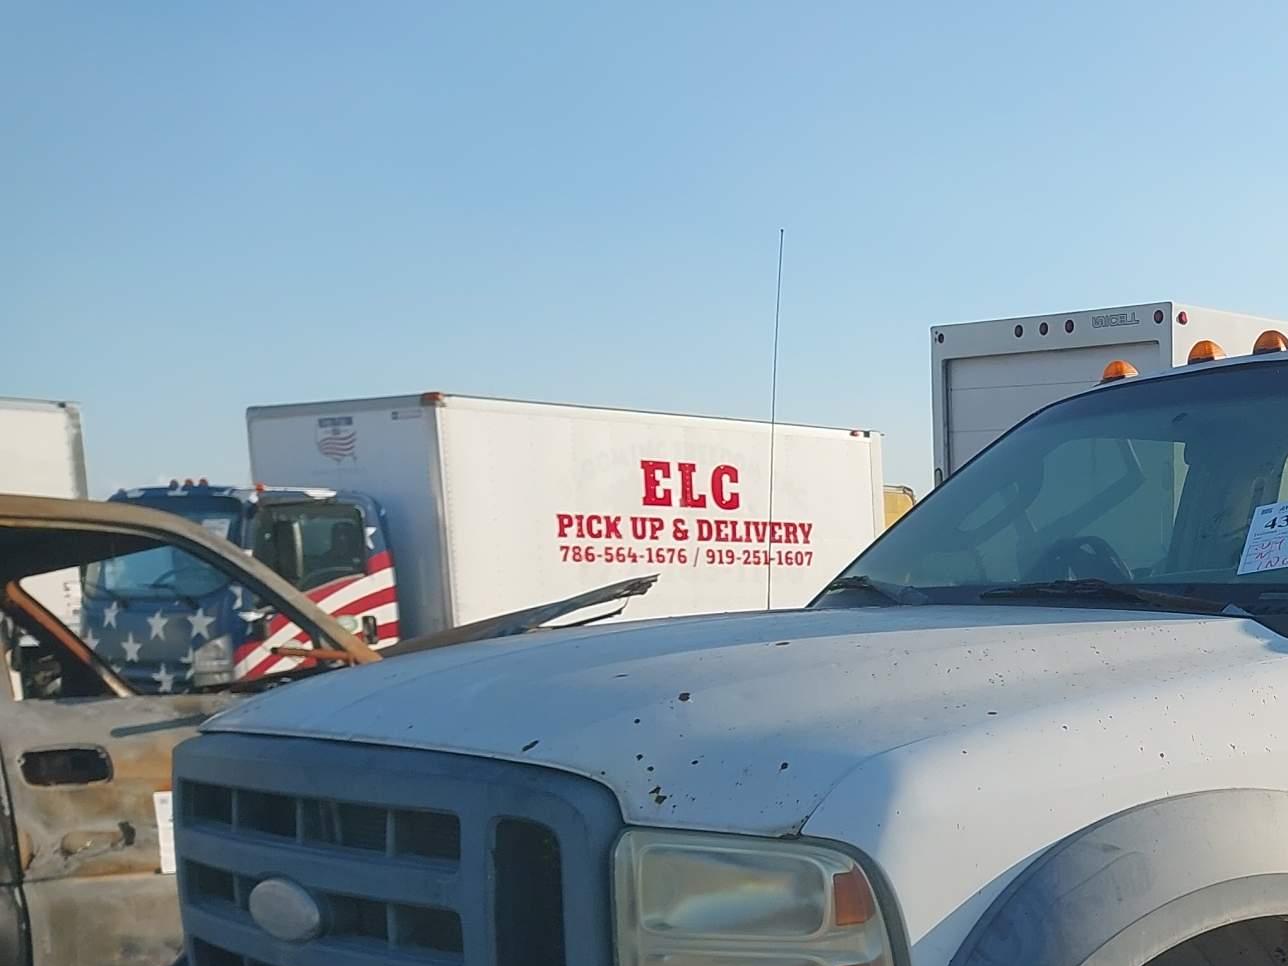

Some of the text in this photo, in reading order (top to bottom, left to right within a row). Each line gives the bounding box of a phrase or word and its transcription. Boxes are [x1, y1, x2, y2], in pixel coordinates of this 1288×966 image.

[640, 459, 741, 510] ELC
[556, 513, 814, 545] PICK UP & DELIVERY
[559, 545, 688, 564] 786-564-1676
[705, 548, 814, 567] 919-251-1607
